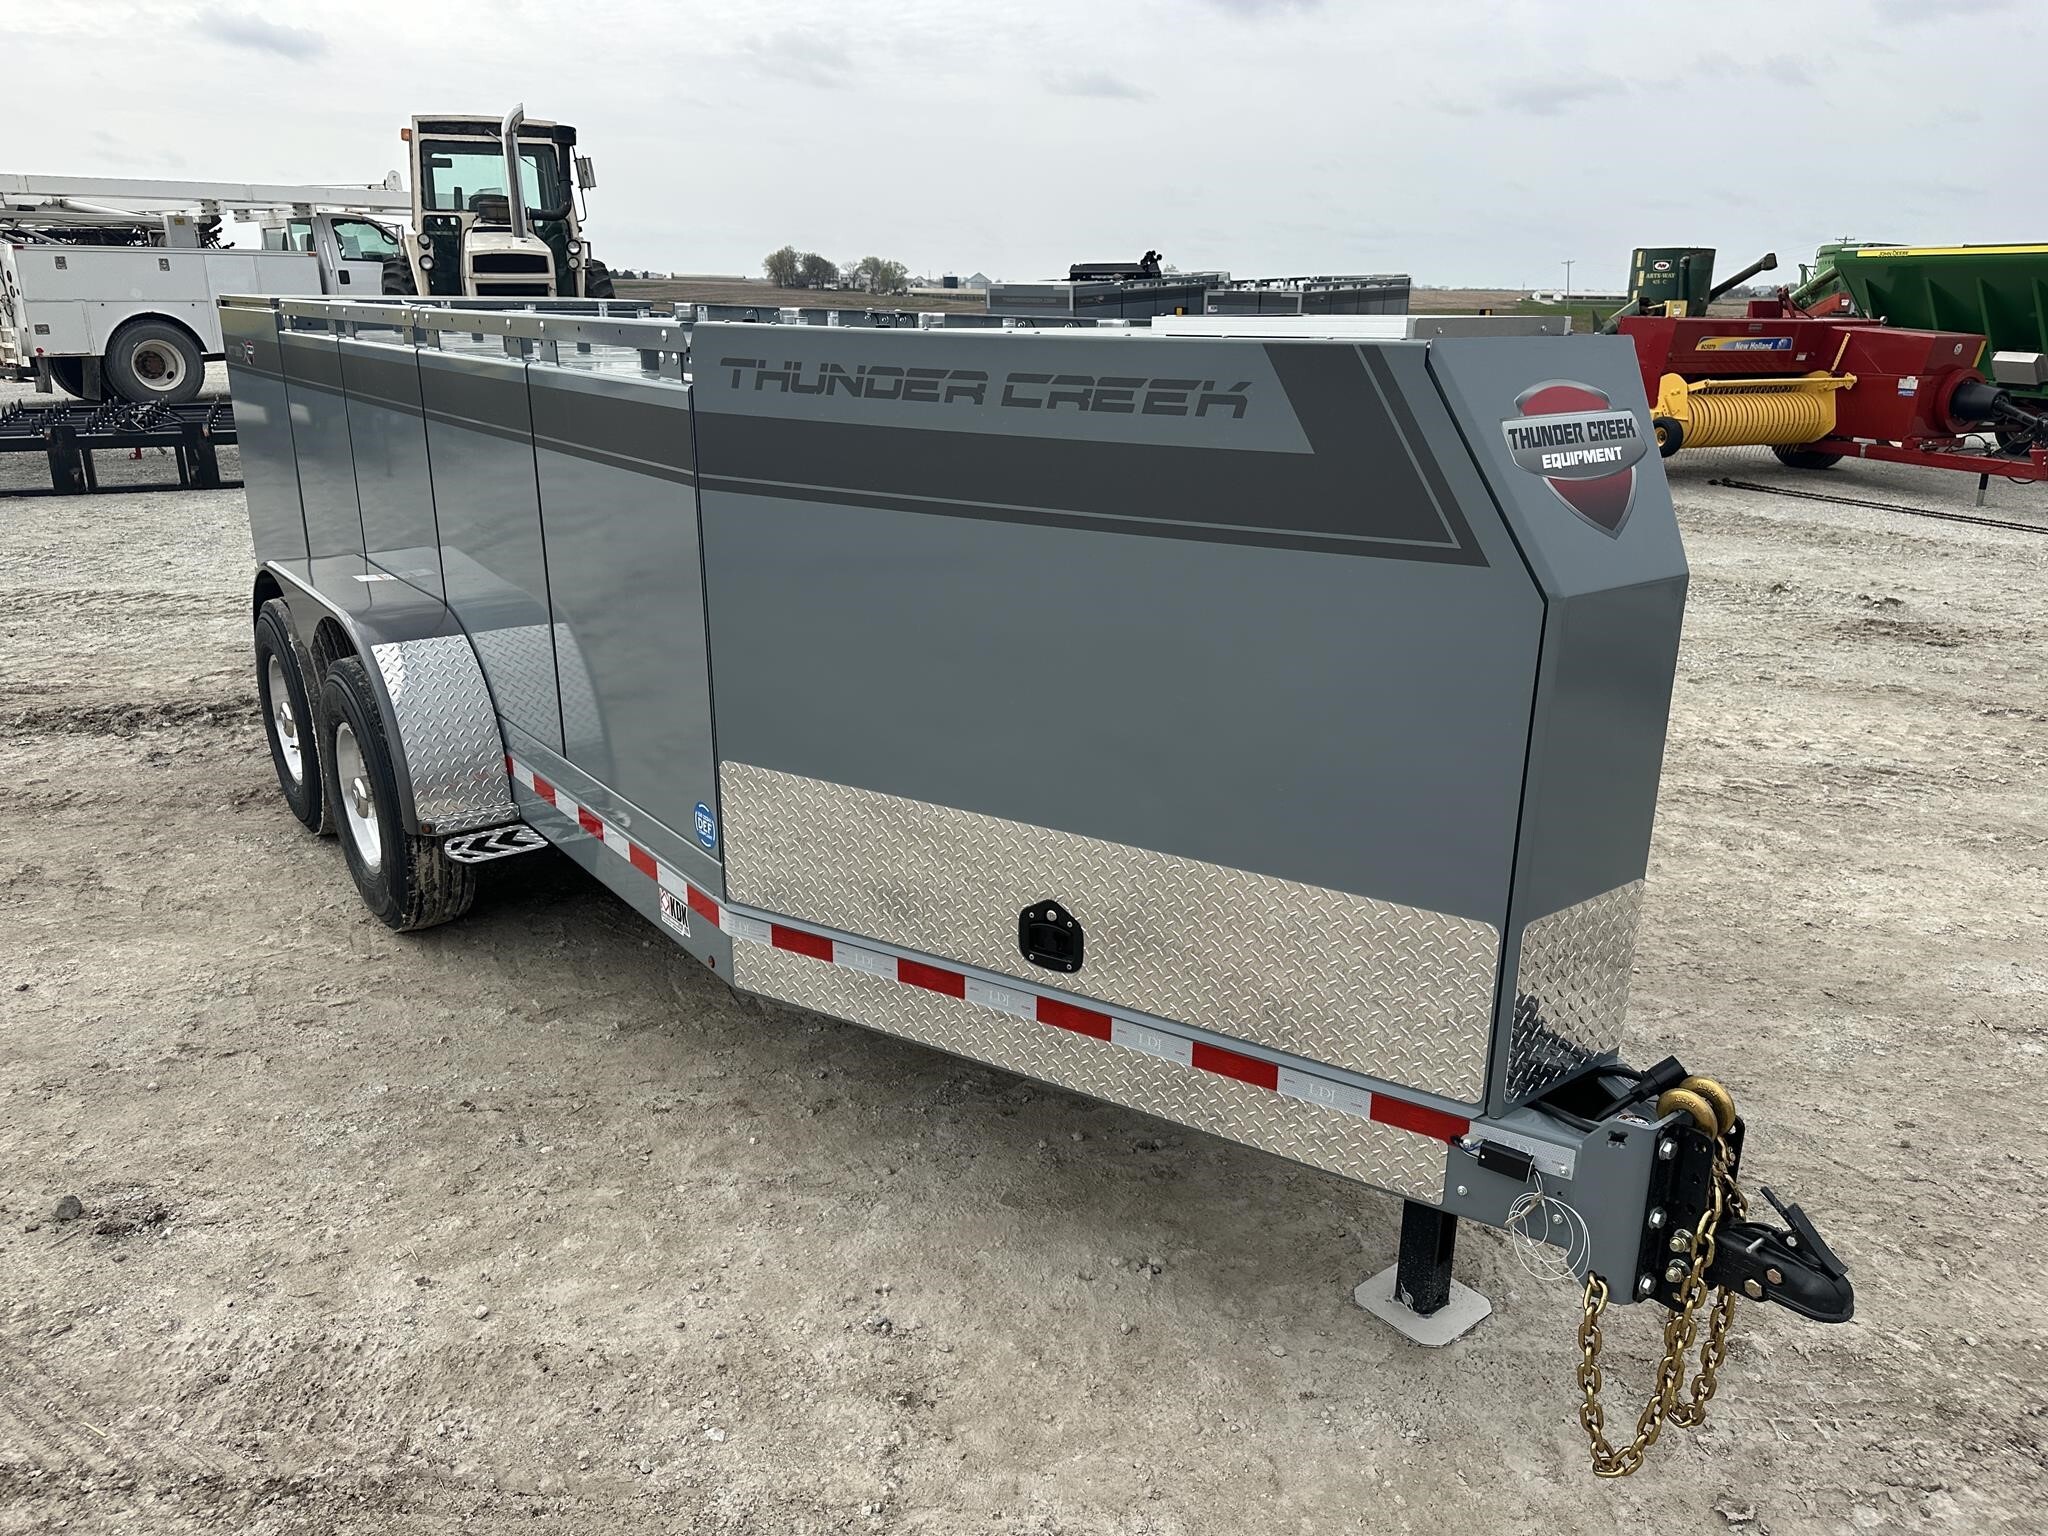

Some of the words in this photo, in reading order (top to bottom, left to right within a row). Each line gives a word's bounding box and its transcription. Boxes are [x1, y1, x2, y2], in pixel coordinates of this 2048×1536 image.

[1734, 342, 1749, 350] New
[1750, 342, 1773, 350] Holland
[720, 357, 989, 405] THUNDER
[1000, 372, 1253, 419] CREEK
[1508, 422, 1585, 450] THUNDER
[1587, 417, 1637, 442] CREEK
[1541, 446, 1622, 469] EQUIPMENT
[697, 816, 712, 834] DEF
[669, 895, 688, 928] KDK
